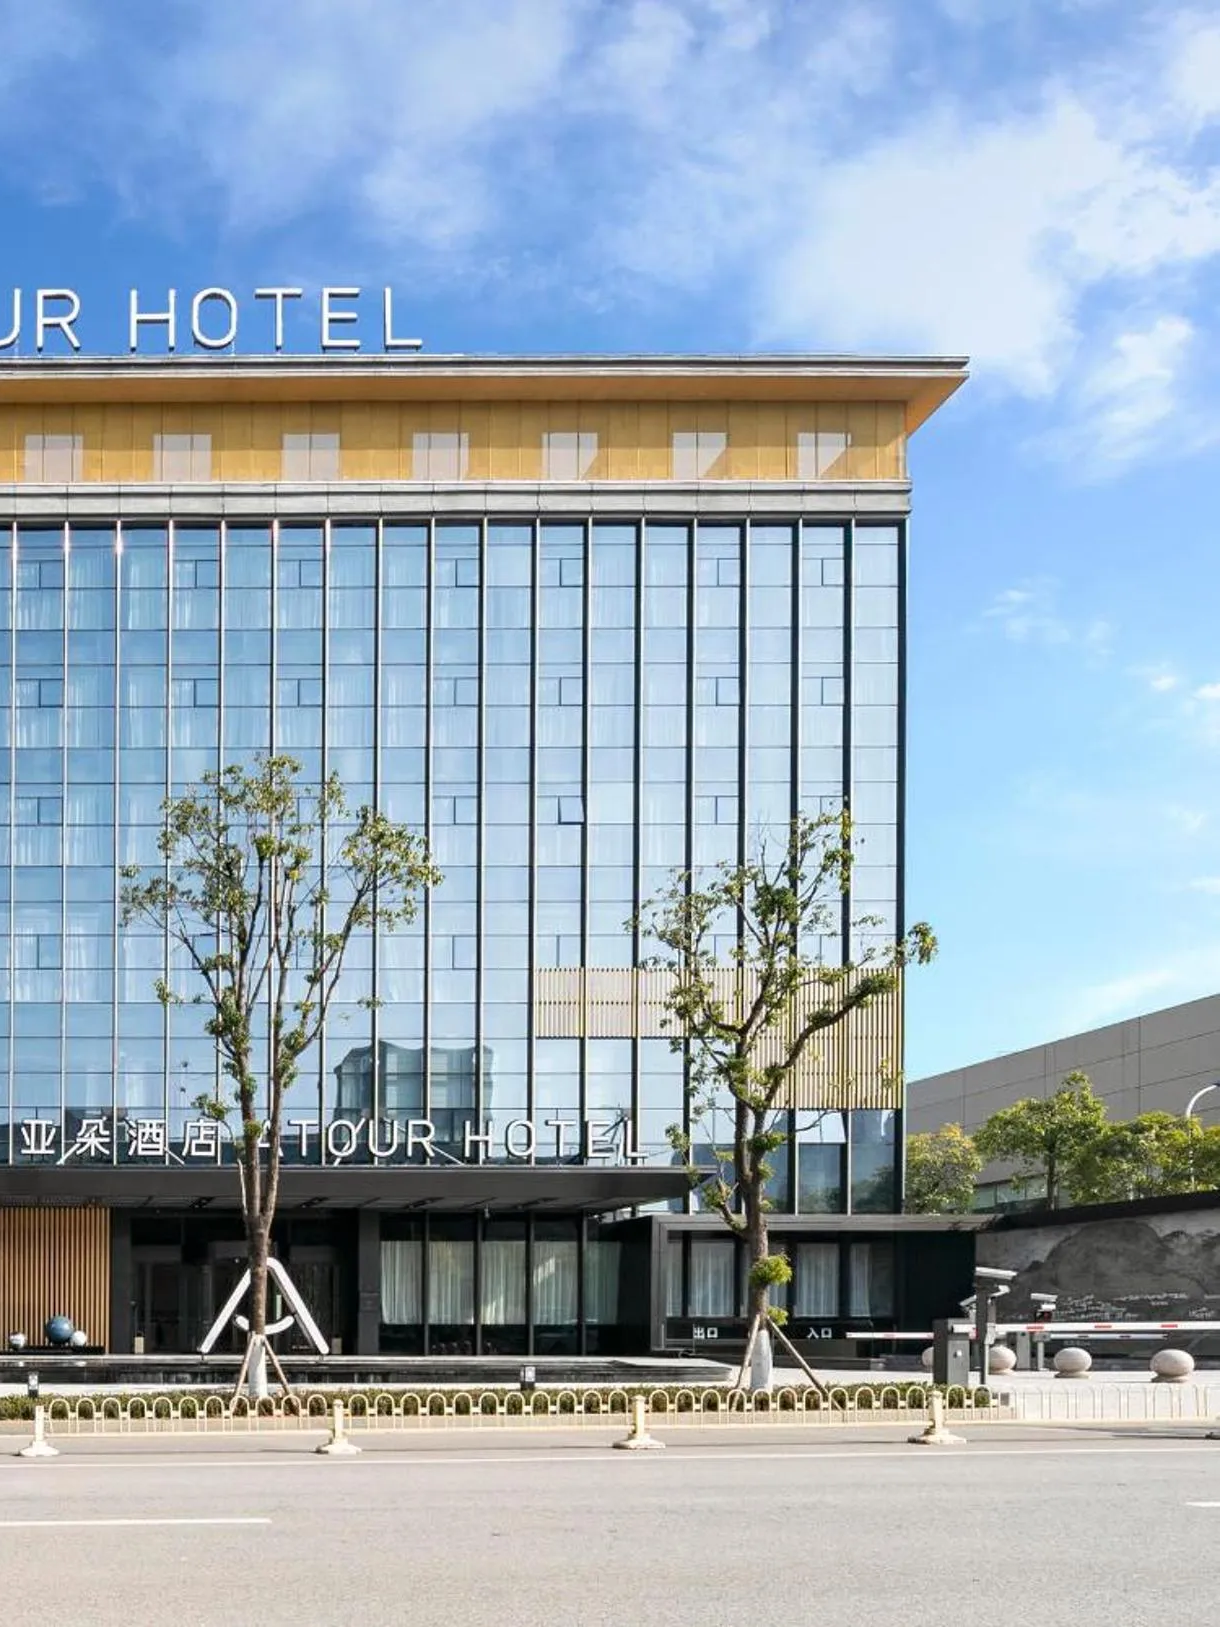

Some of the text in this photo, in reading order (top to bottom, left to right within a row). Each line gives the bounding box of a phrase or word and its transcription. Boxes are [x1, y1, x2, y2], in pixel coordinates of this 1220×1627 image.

[129, 287, 422, 351] HOTEL
[20, 1118, 217, 1157] 亚朵酒店
[464, 1119, 648, 1160] HOTEL
[693, 1327, 718, 1339] 出口
[807, 1327, 832, 1339] 入口
